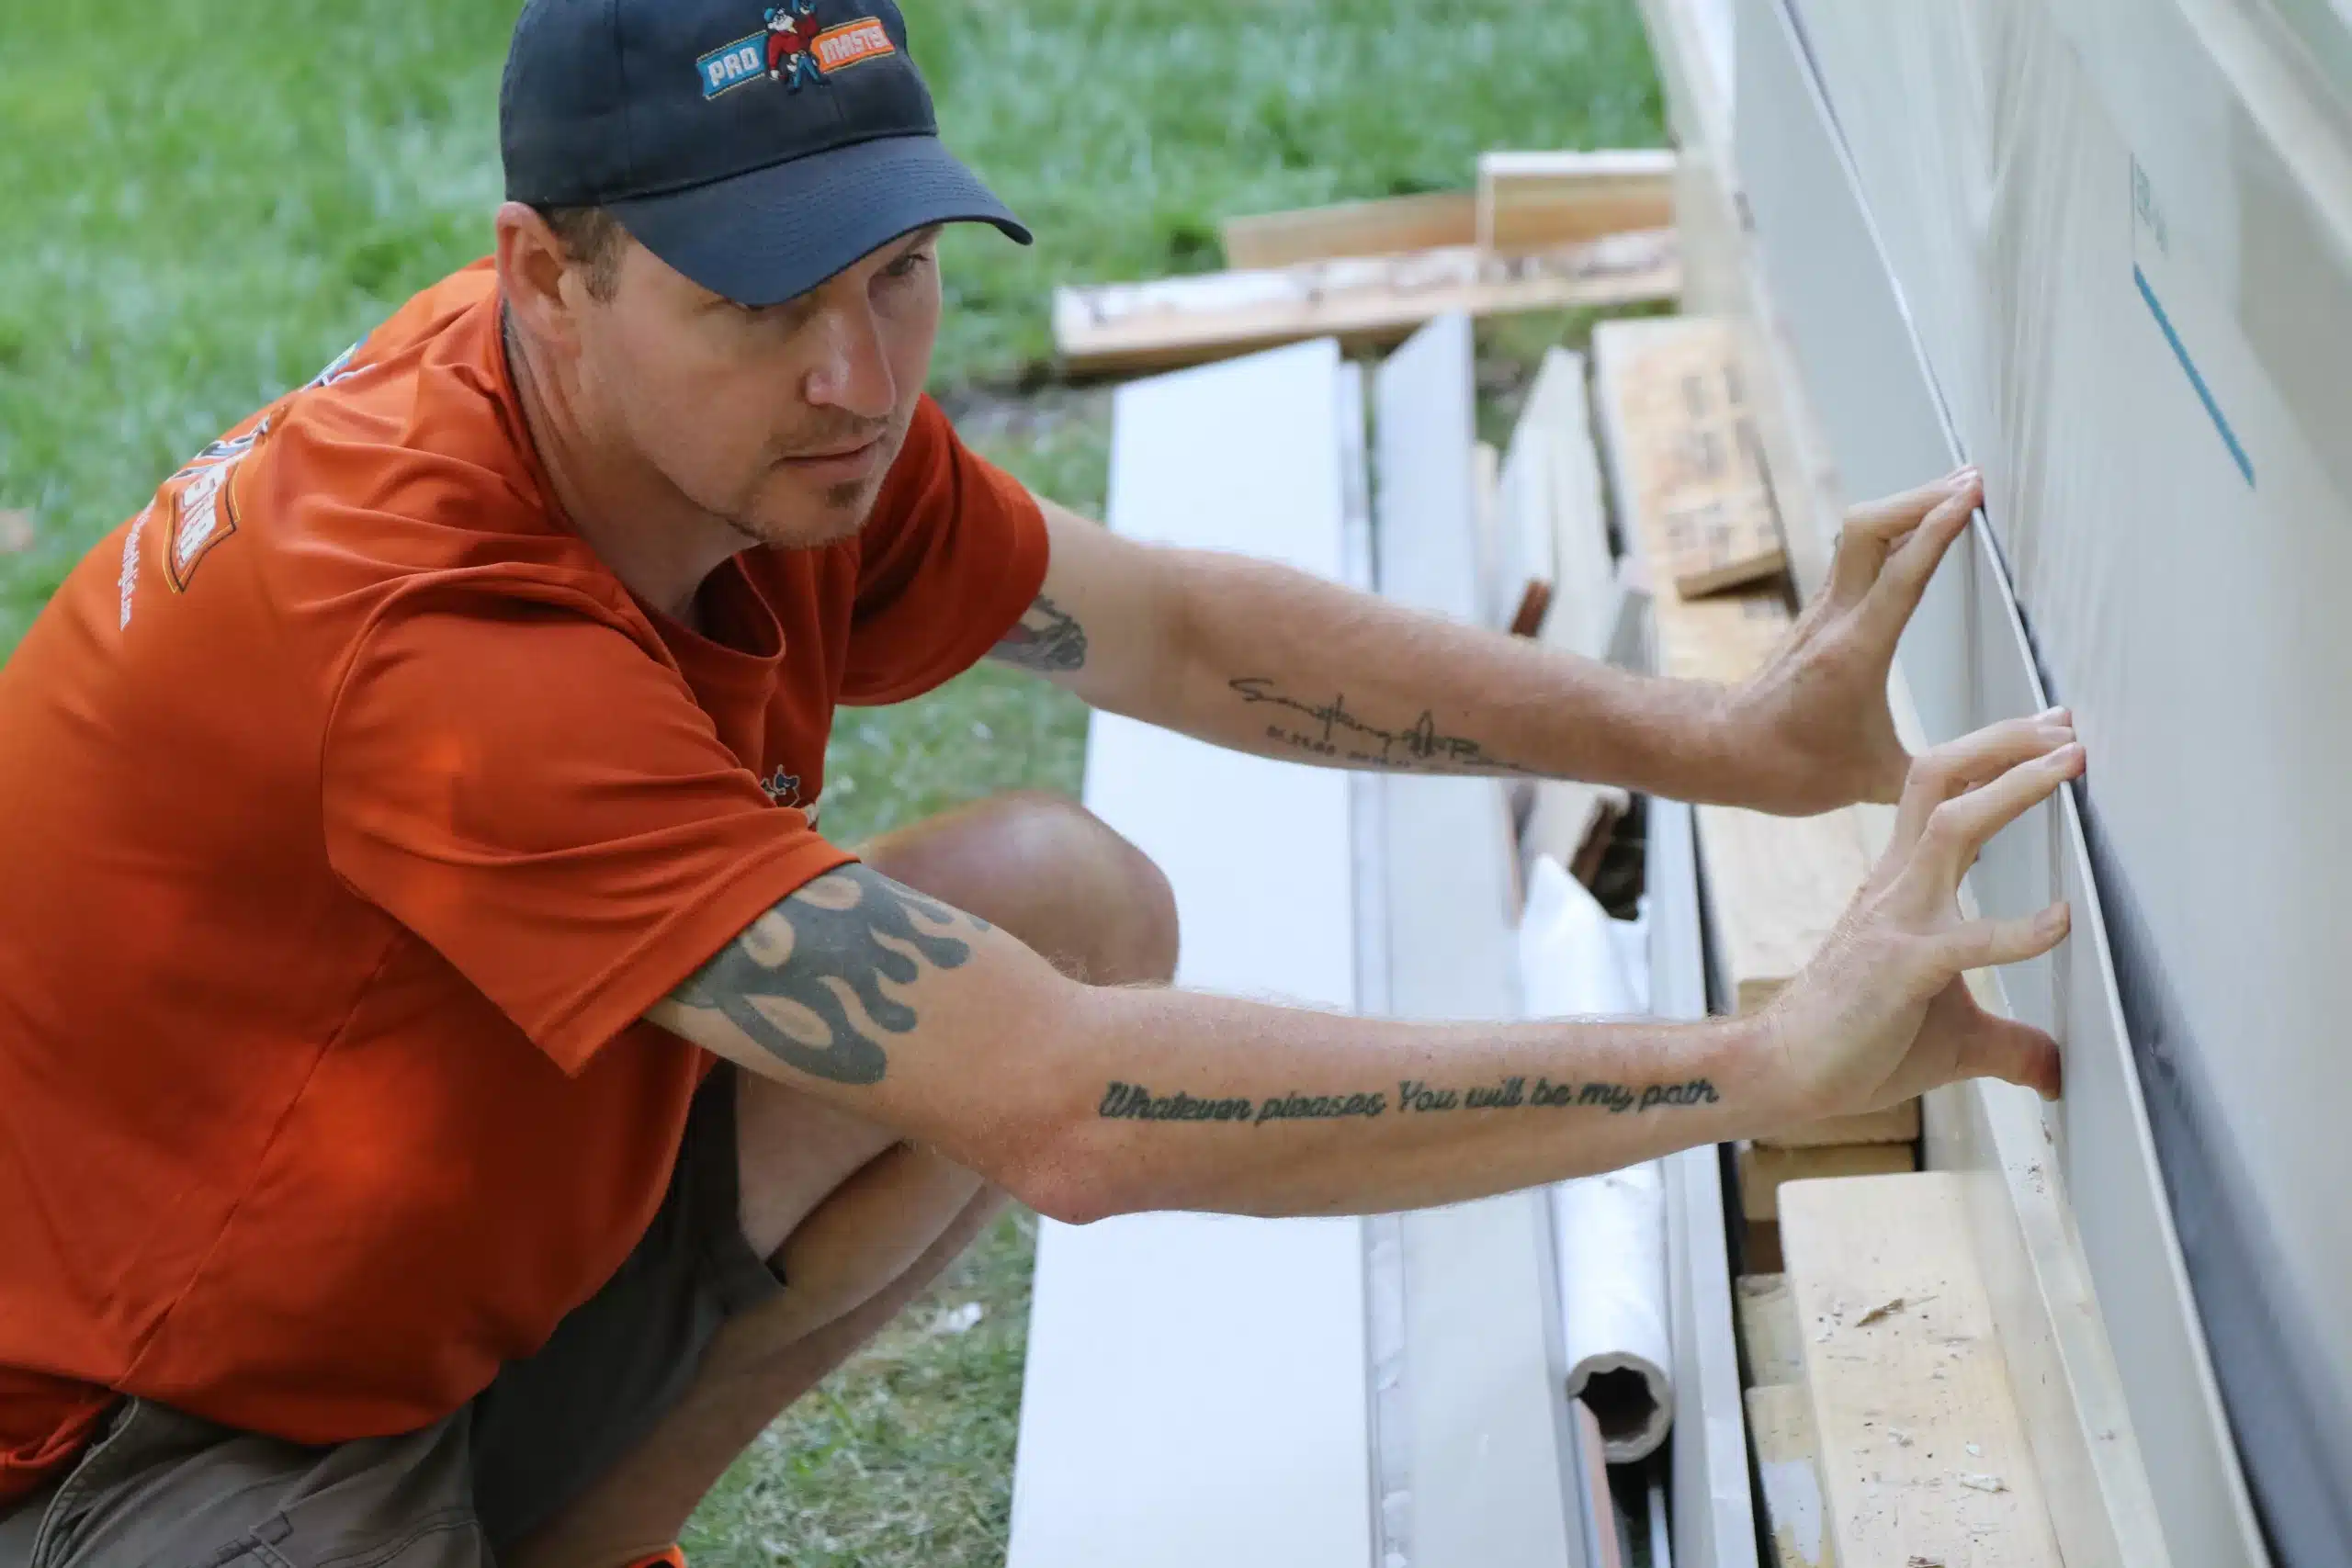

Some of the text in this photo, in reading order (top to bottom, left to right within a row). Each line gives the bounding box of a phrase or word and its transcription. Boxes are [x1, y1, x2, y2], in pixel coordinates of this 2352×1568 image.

[707, 47, 759, 87] PRO
[1100, 1076, 1720, 1127] Whatever pleases You will be my path
